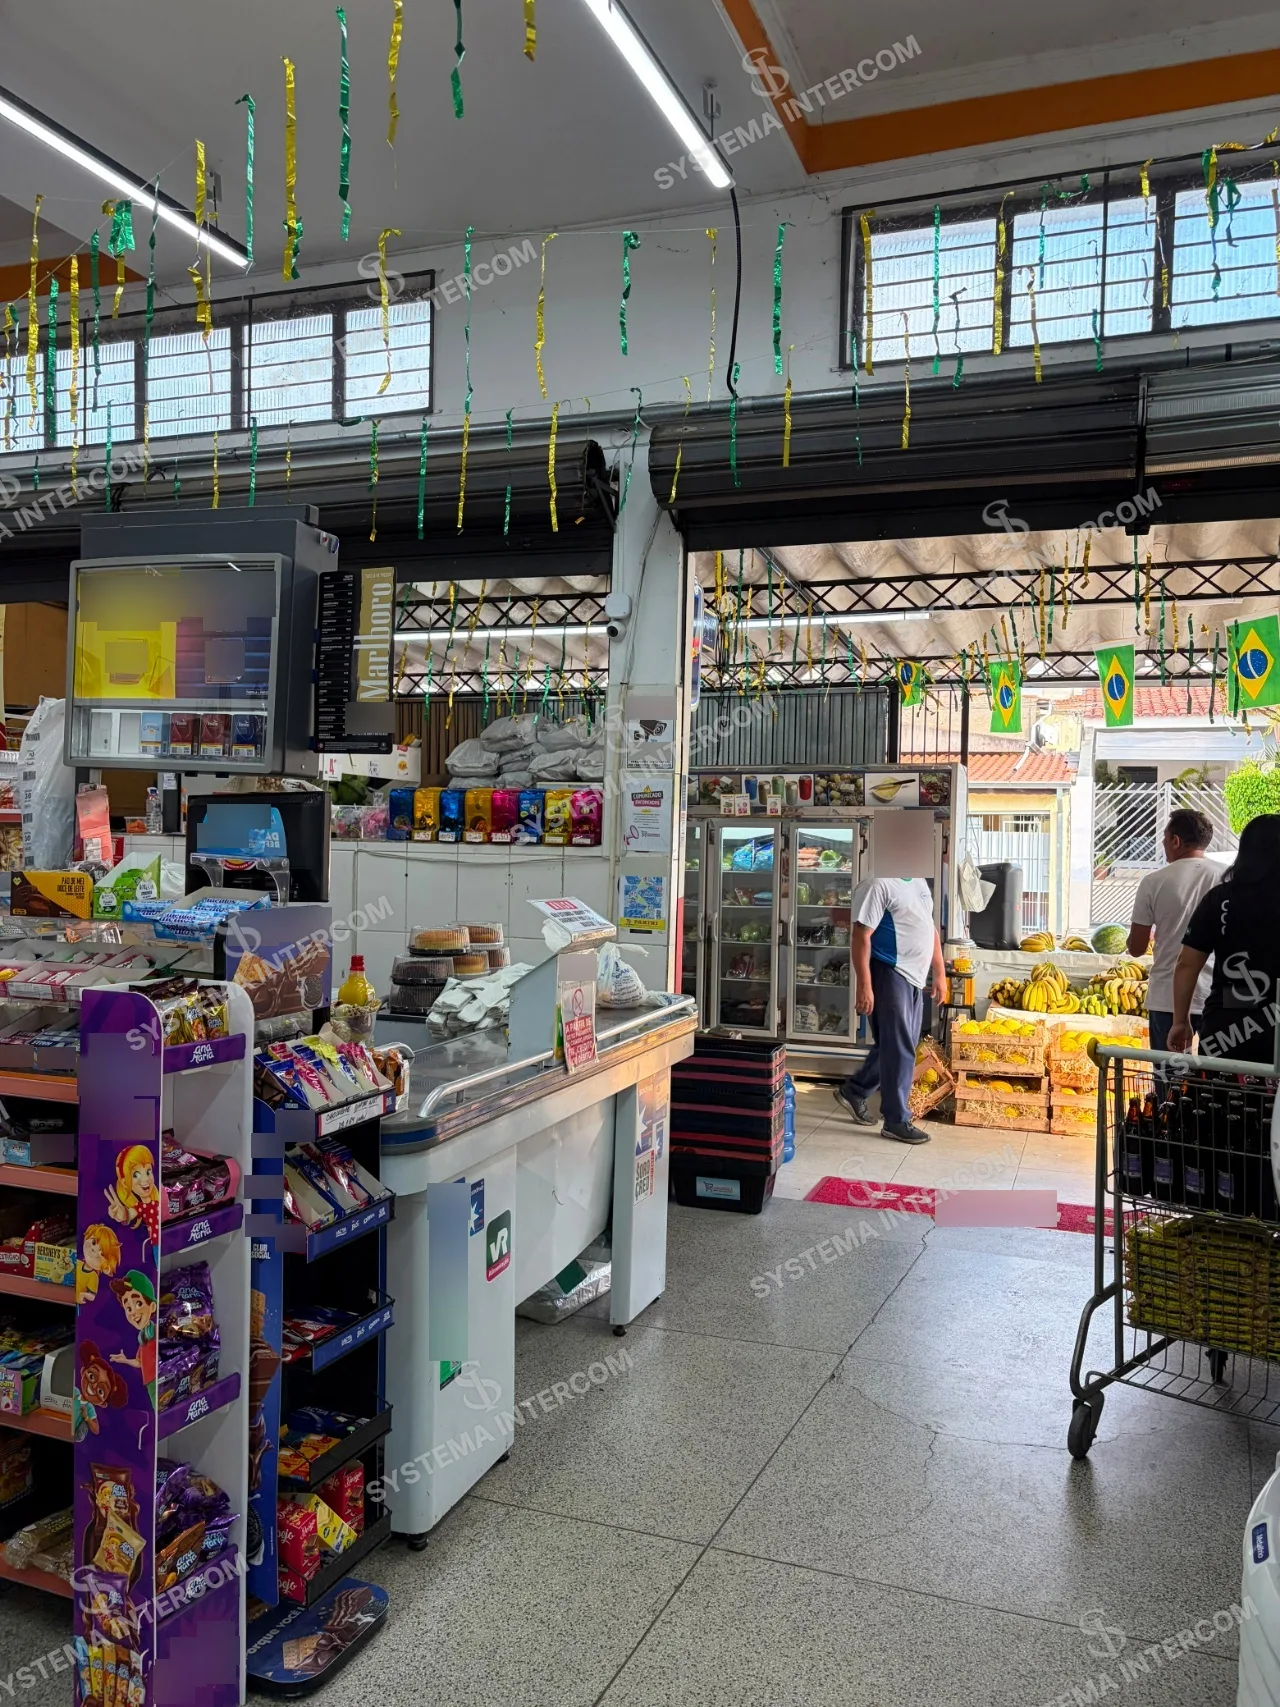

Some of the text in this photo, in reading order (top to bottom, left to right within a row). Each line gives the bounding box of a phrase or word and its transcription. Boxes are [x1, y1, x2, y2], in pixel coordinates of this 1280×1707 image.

[353, 583, 391, 699] Marlboro
[37, 1245, 61, 1258] HERSHEY'S
[251, 1251, 271, 1260] SOCIAL
[252, 1243, 268, 1252] CLUB
[488, 1258, 510, 1277] Alimentação
[277, 1610, 299, 1629] VOCÊ
